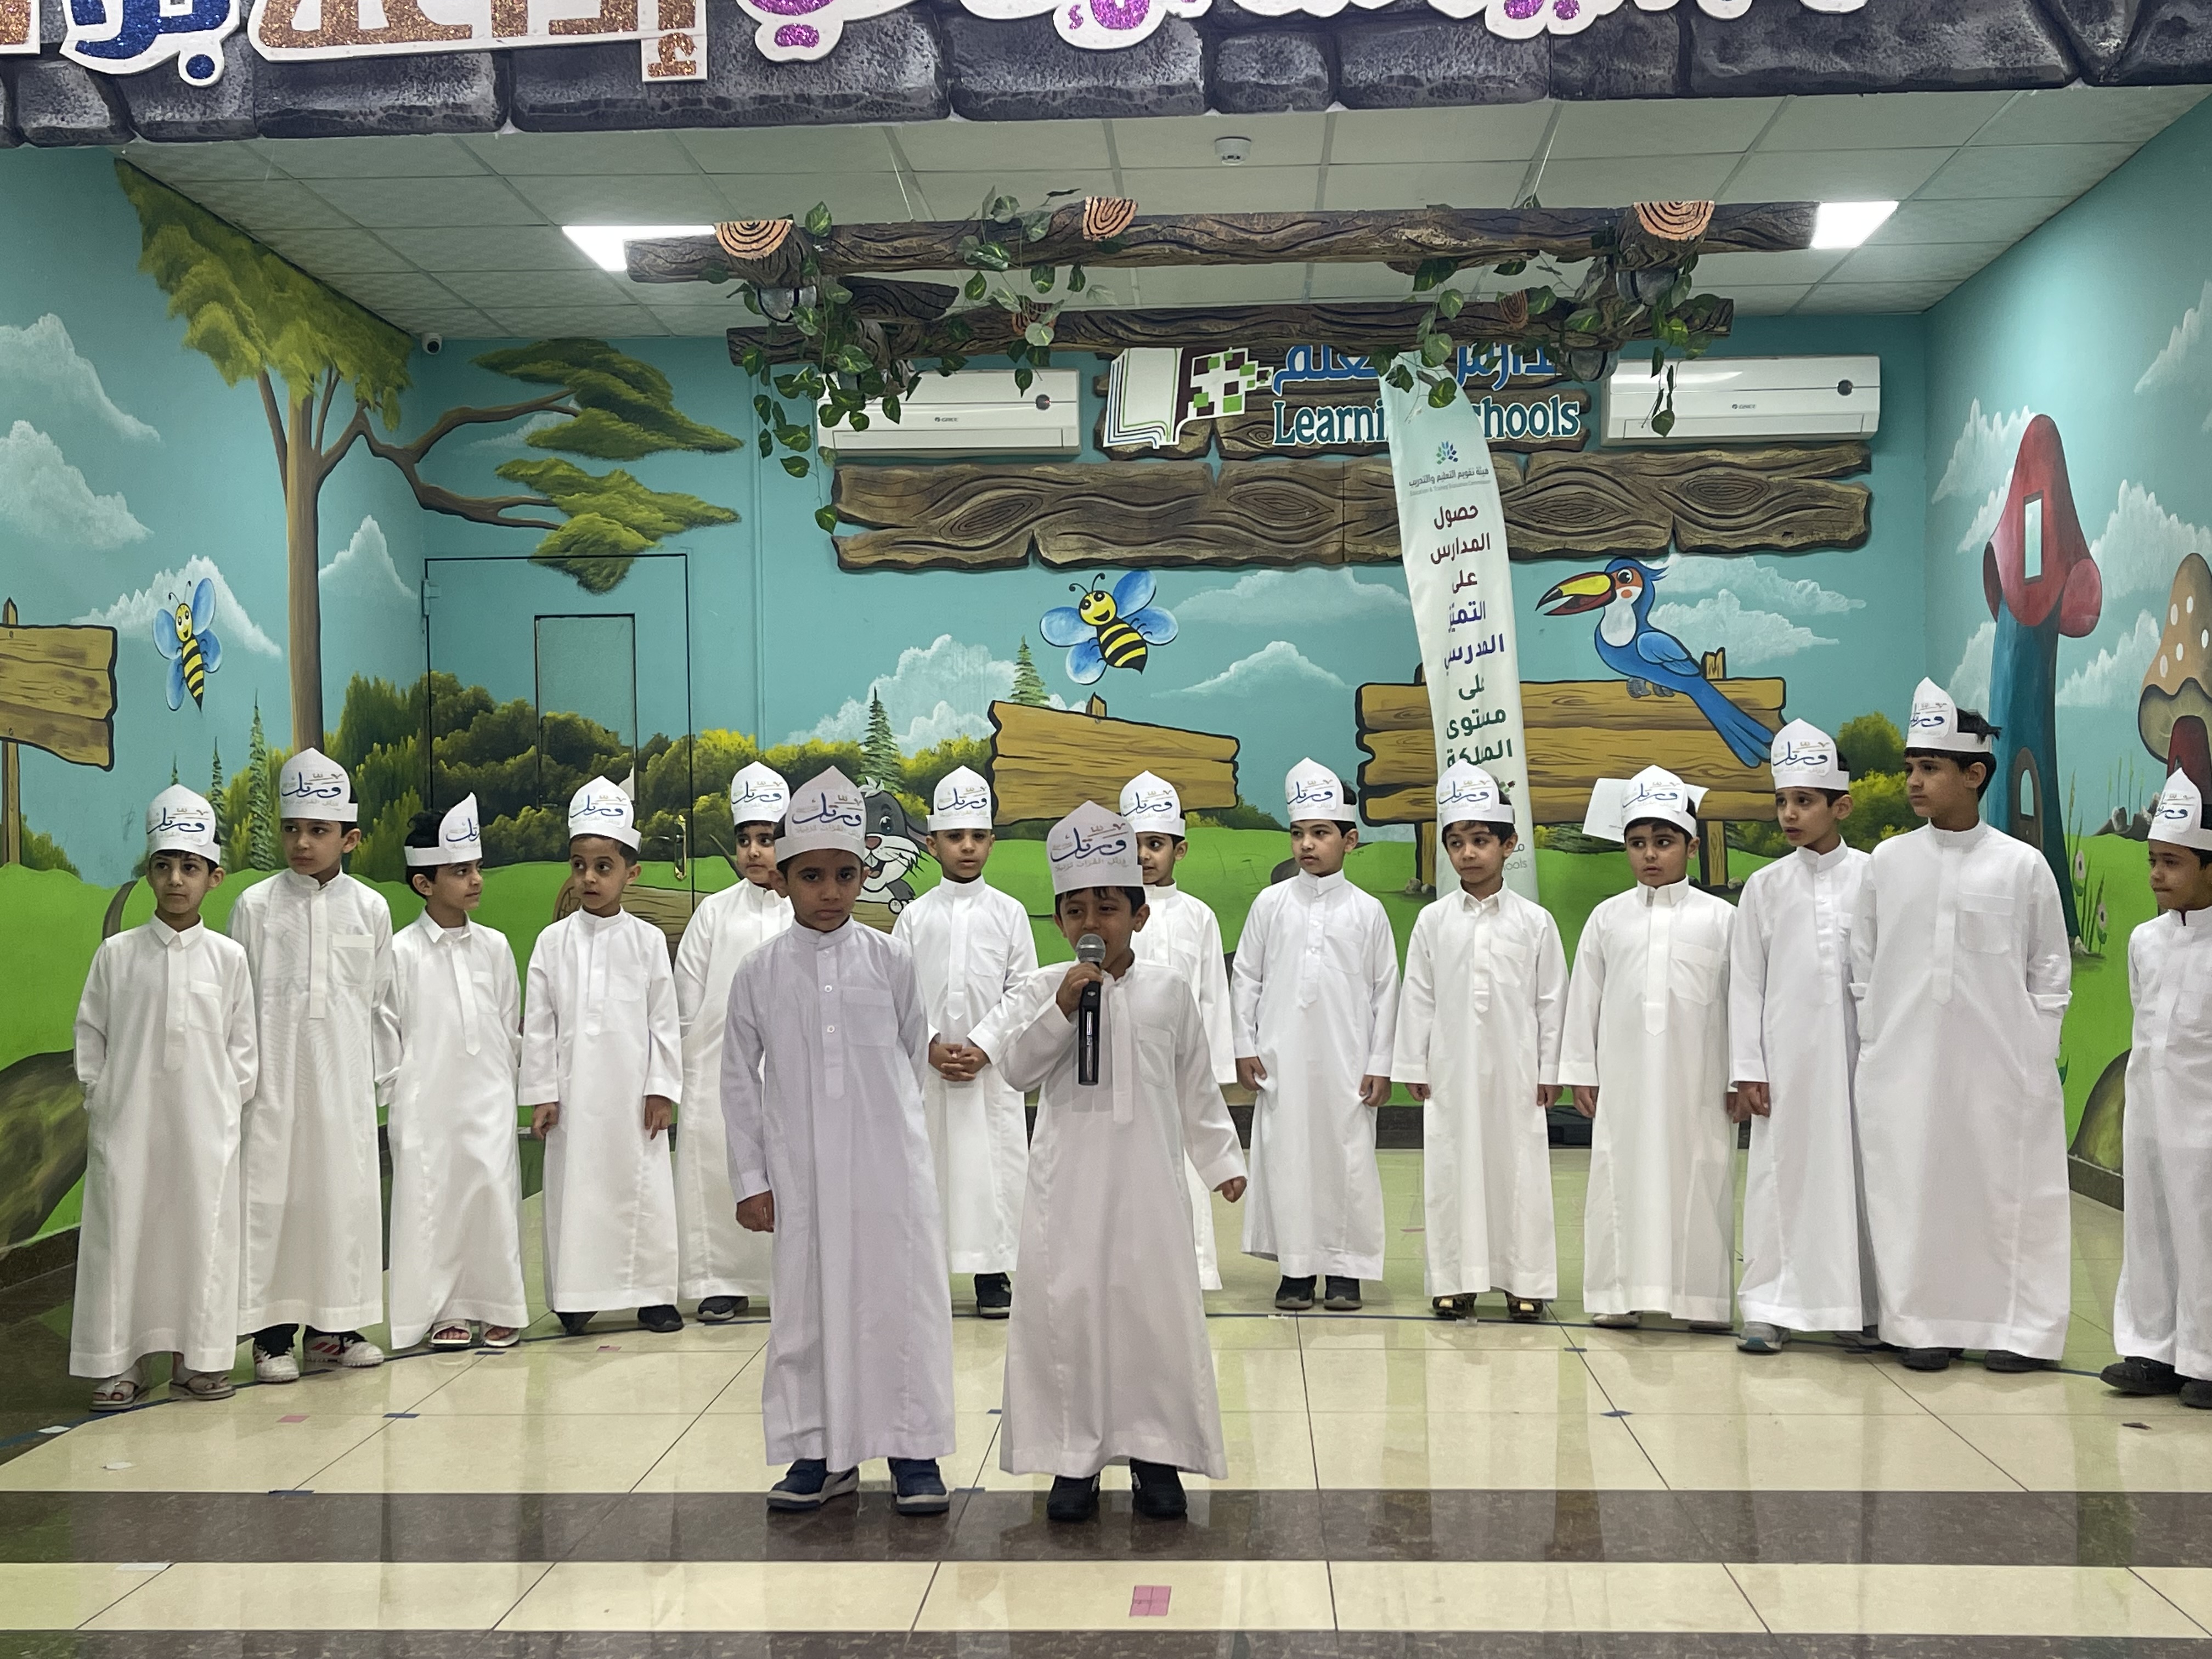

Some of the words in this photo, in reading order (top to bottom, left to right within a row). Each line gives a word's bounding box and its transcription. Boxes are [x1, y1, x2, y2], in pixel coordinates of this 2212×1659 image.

[1273, 398, 1385, 444] Learni
[1472, 395, 1580, 438] hools
[1434, 505, 1479, 530] حصول
[1430, 532, 1491, 565] المدارس
[1452, 569, 1478, 594] على
[1446, 708, 1506, 740] مستوى
[1505, 857, 1528, 870] ools
